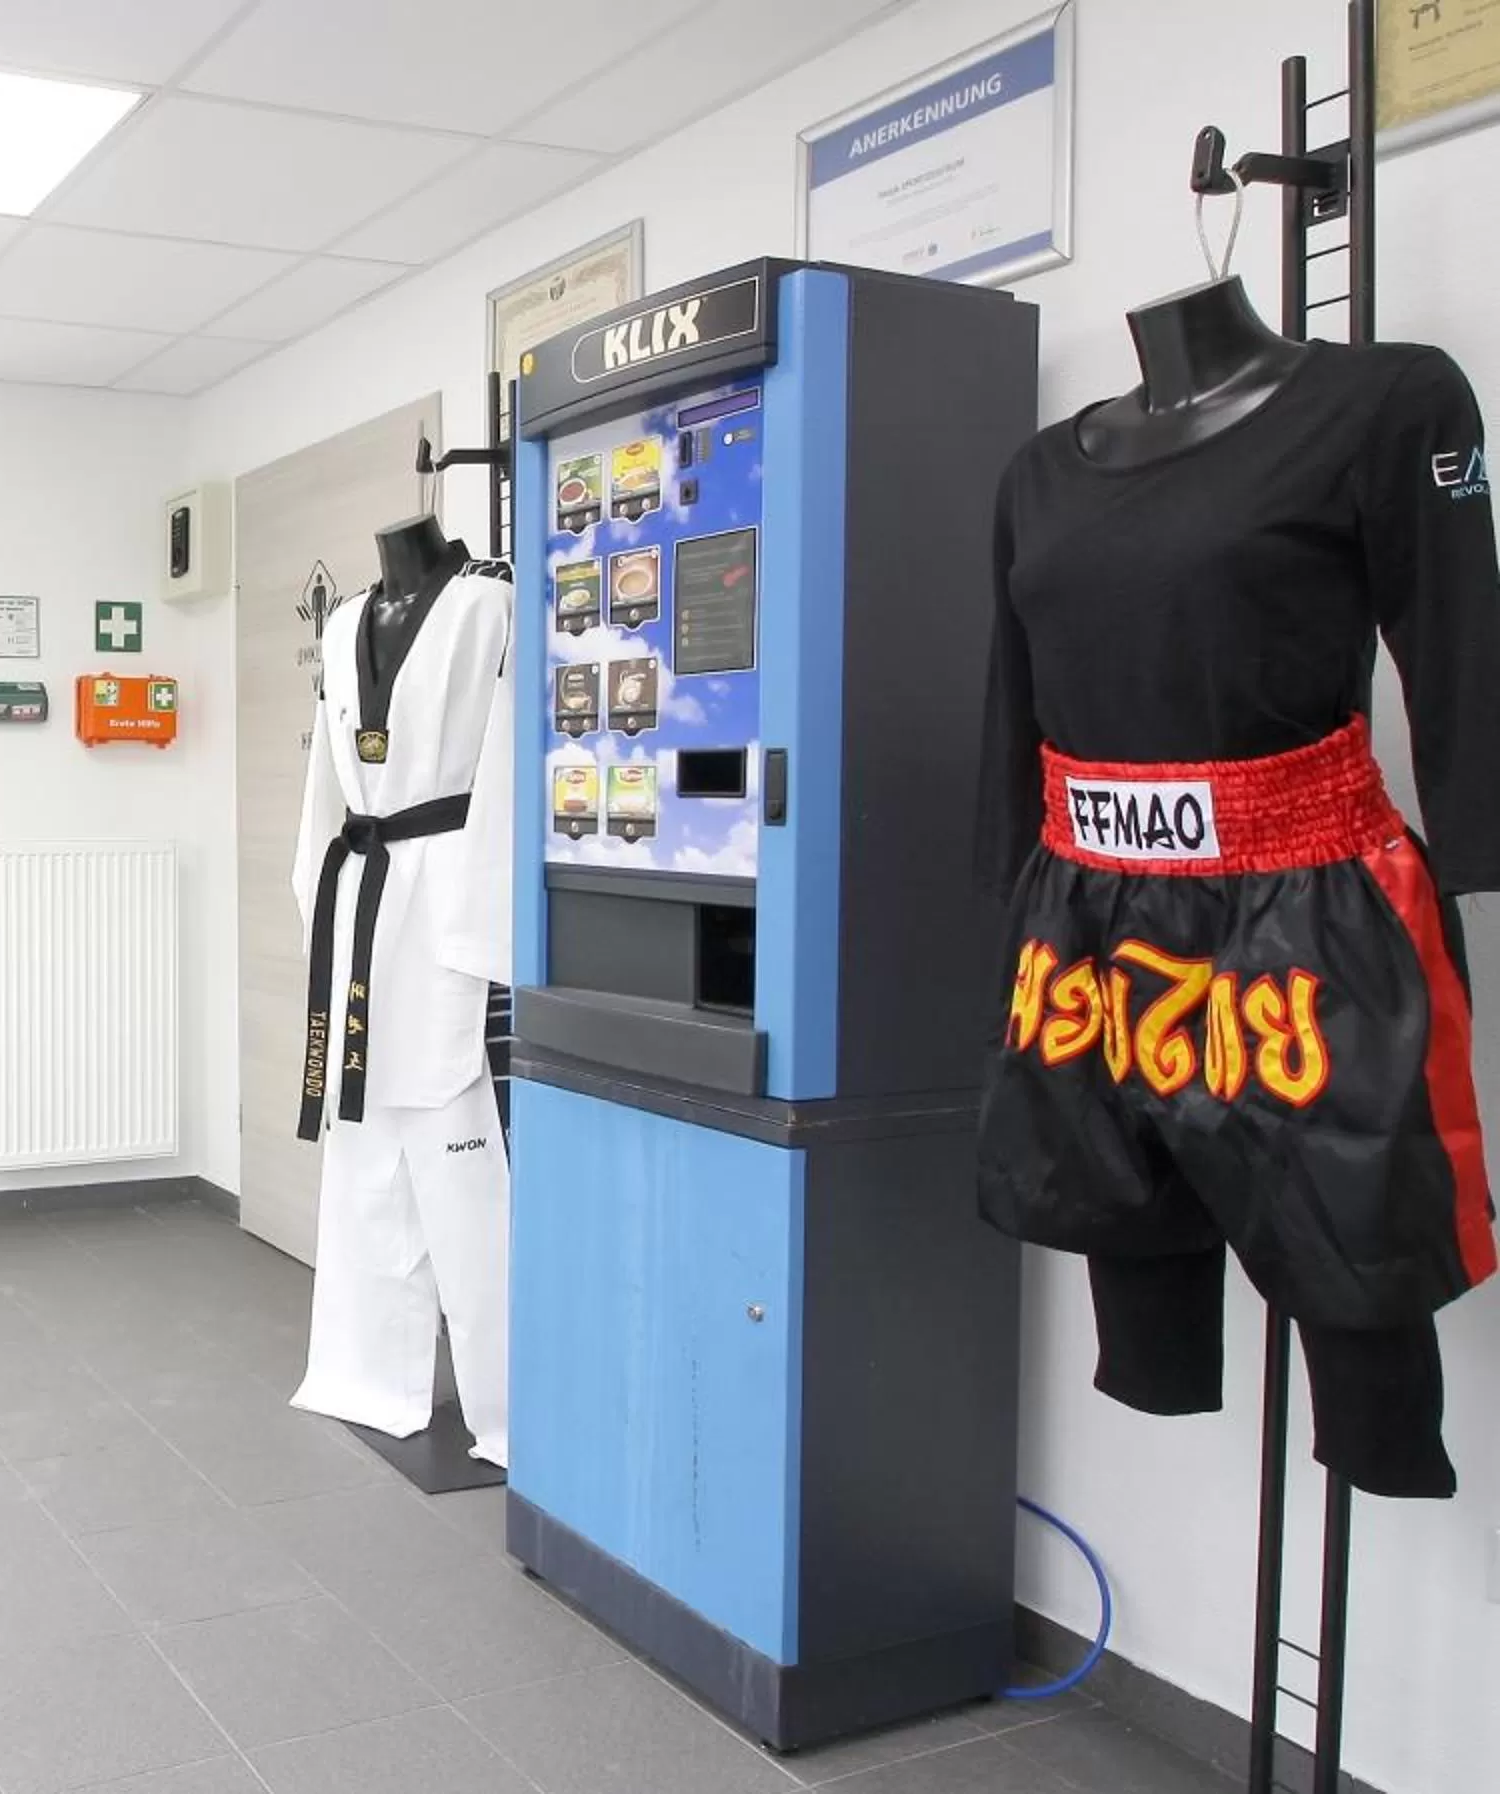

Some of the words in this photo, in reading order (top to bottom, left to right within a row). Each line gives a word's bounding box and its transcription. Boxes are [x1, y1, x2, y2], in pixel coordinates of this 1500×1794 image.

[848, 71, 1003, 159] ANERKENNUNG
[602, 296, 703, 371] KLIX
[1069, 786, 1206, 851] FFMAO
[306, 1011, 327, 1097] TAEKWONDO
[446, 1137, 487, 1153] KWON
